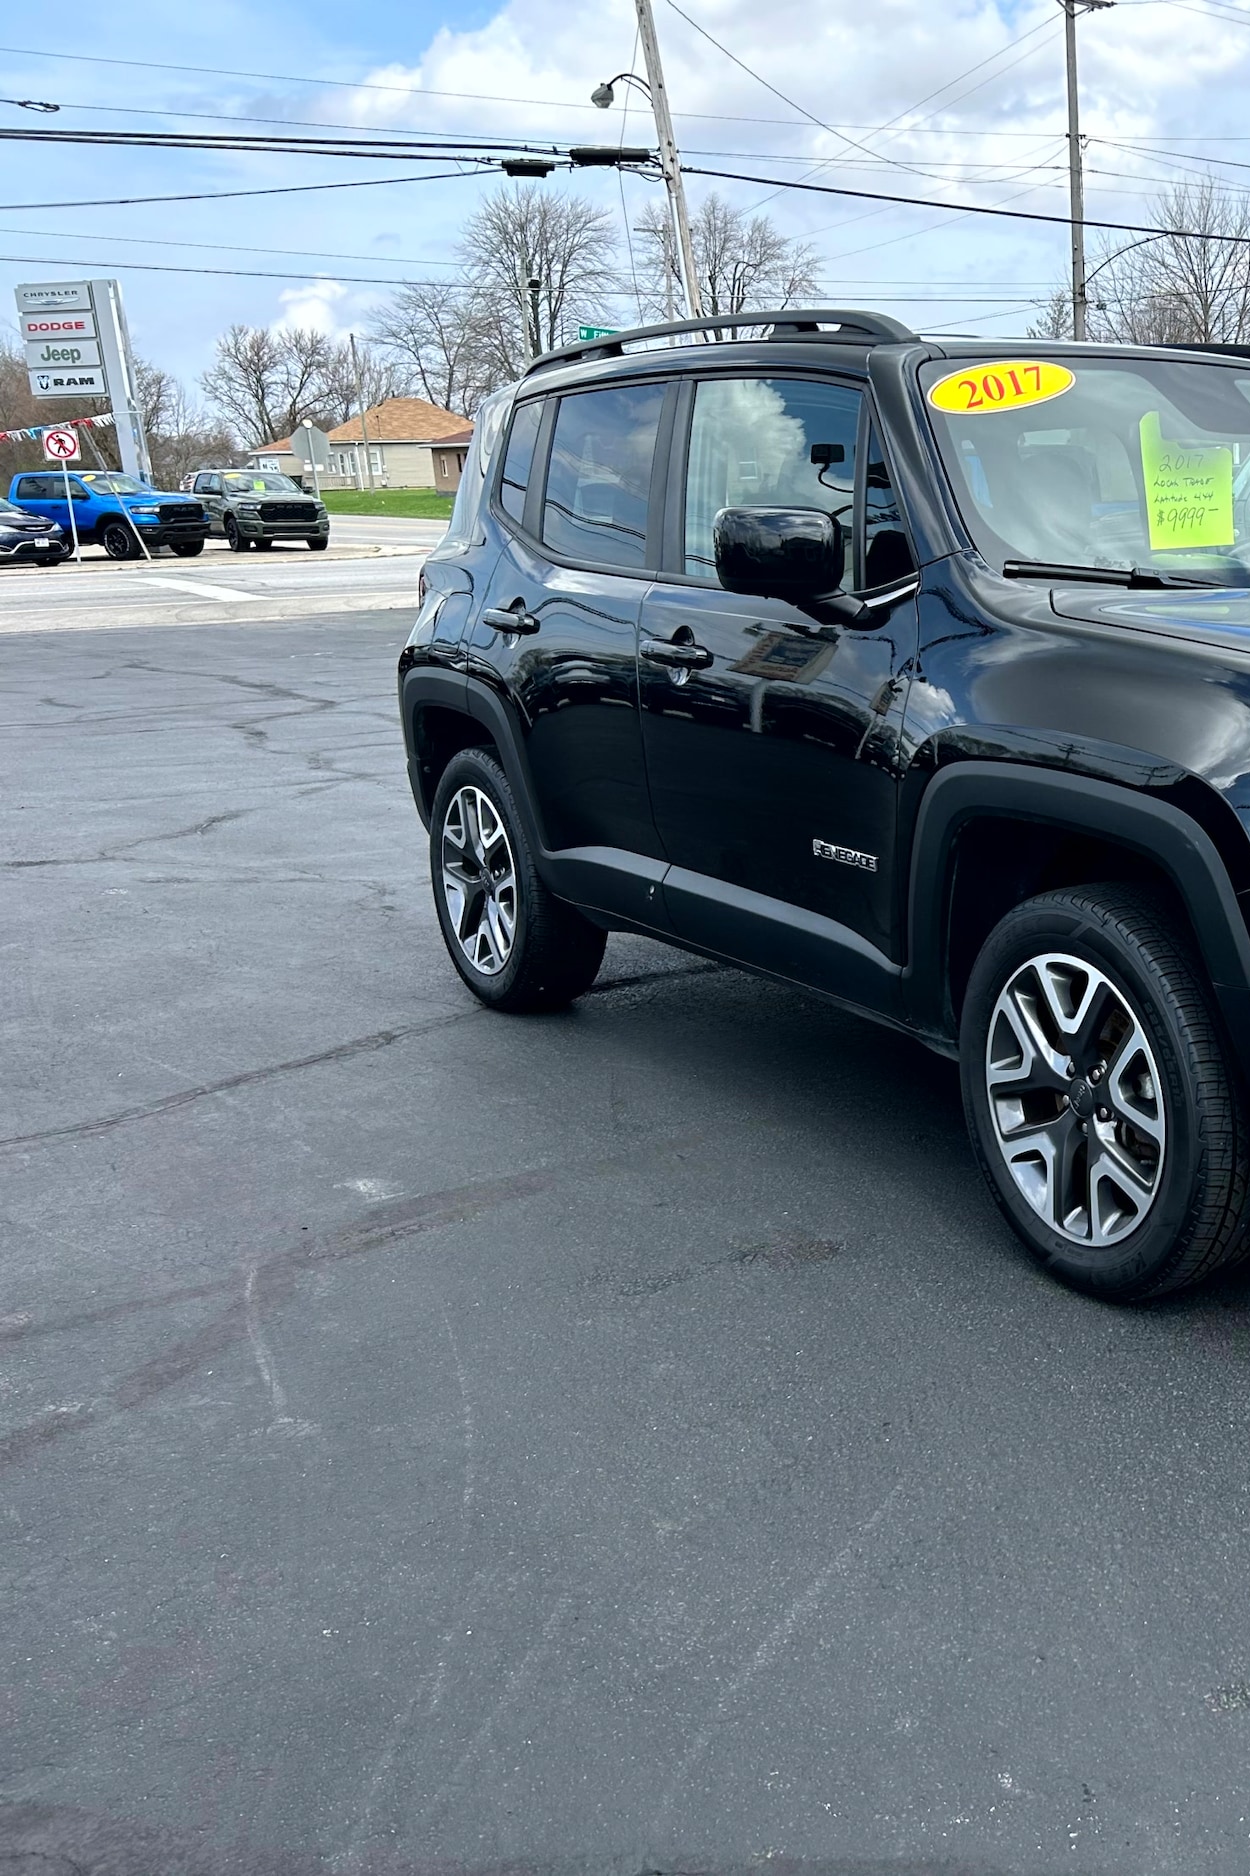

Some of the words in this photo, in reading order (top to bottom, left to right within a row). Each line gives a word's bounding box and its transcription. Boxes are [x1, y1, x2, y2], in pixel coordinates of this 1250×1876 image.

[23, 290, 78, 298] CHRYSLER
[27, 321, 86, 332] DODGE
[40, 345, 81, 364] Jeep
[53, 377, 95, 387] RAM
[957, 365, 1045, 409] 2017
[1159, 454, 1205, 472] 2017
[813, 839, 879, 872] RENEGADE
